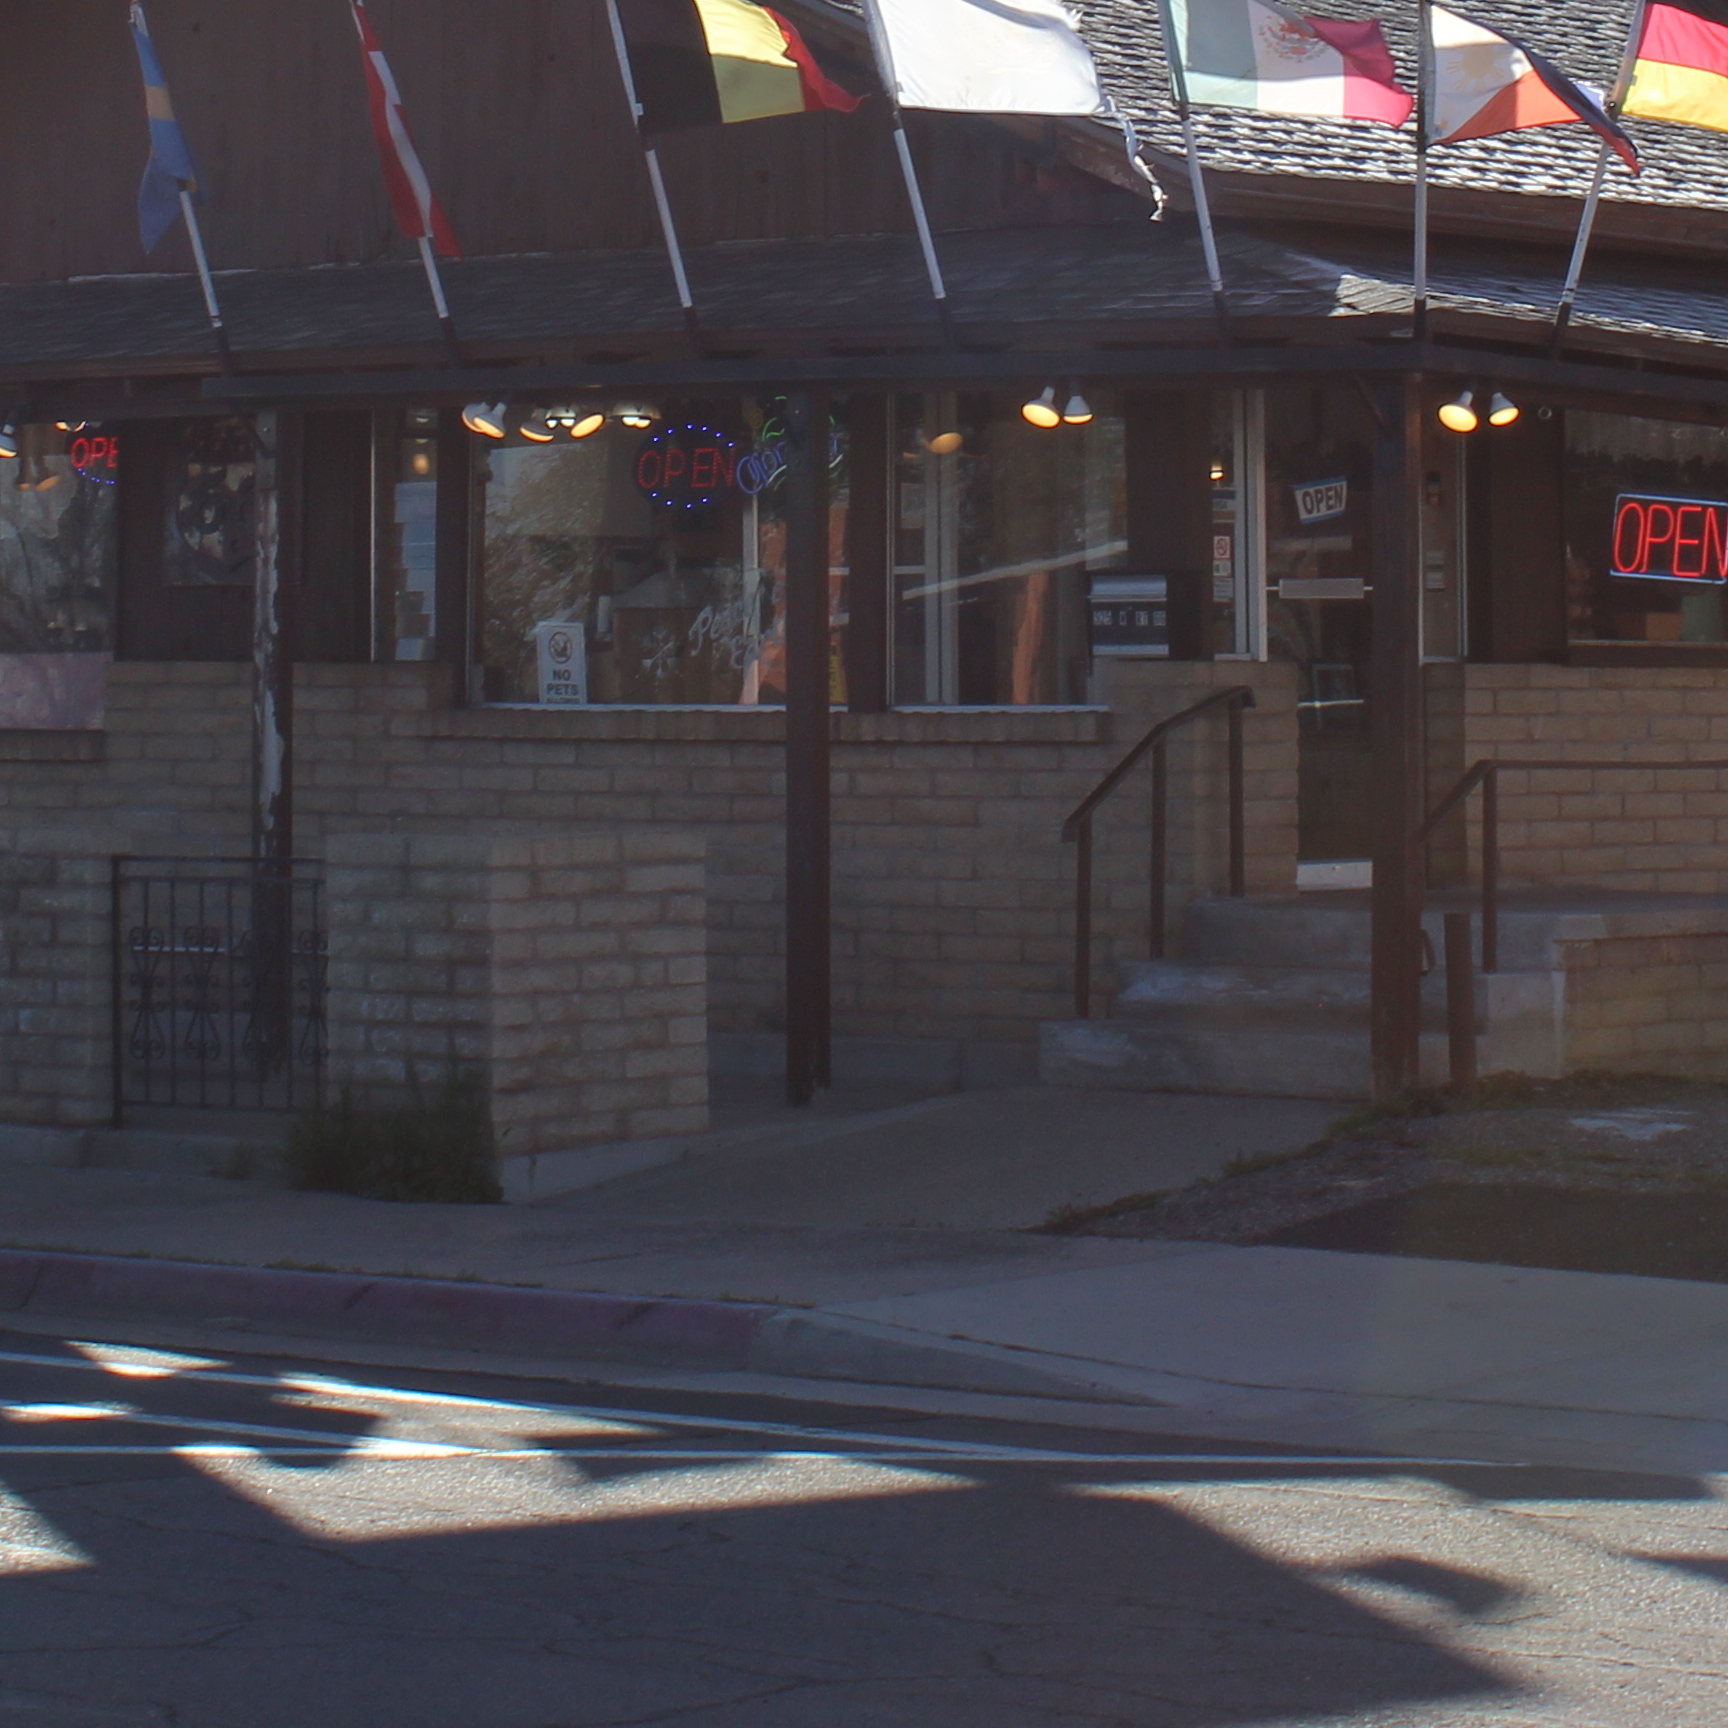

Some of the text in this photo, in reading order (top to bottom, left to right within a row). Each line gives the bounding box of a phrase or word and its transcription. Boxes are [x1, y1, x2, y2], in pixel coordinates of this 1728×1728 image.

[70, 436, 120, 469] OPE
[637, 446, 736, 489] OPEN
[1302, 483, 1344, 516] OPEN
[546, 683, 579, 696] PETS
[553, 669, 571, 681] NO
